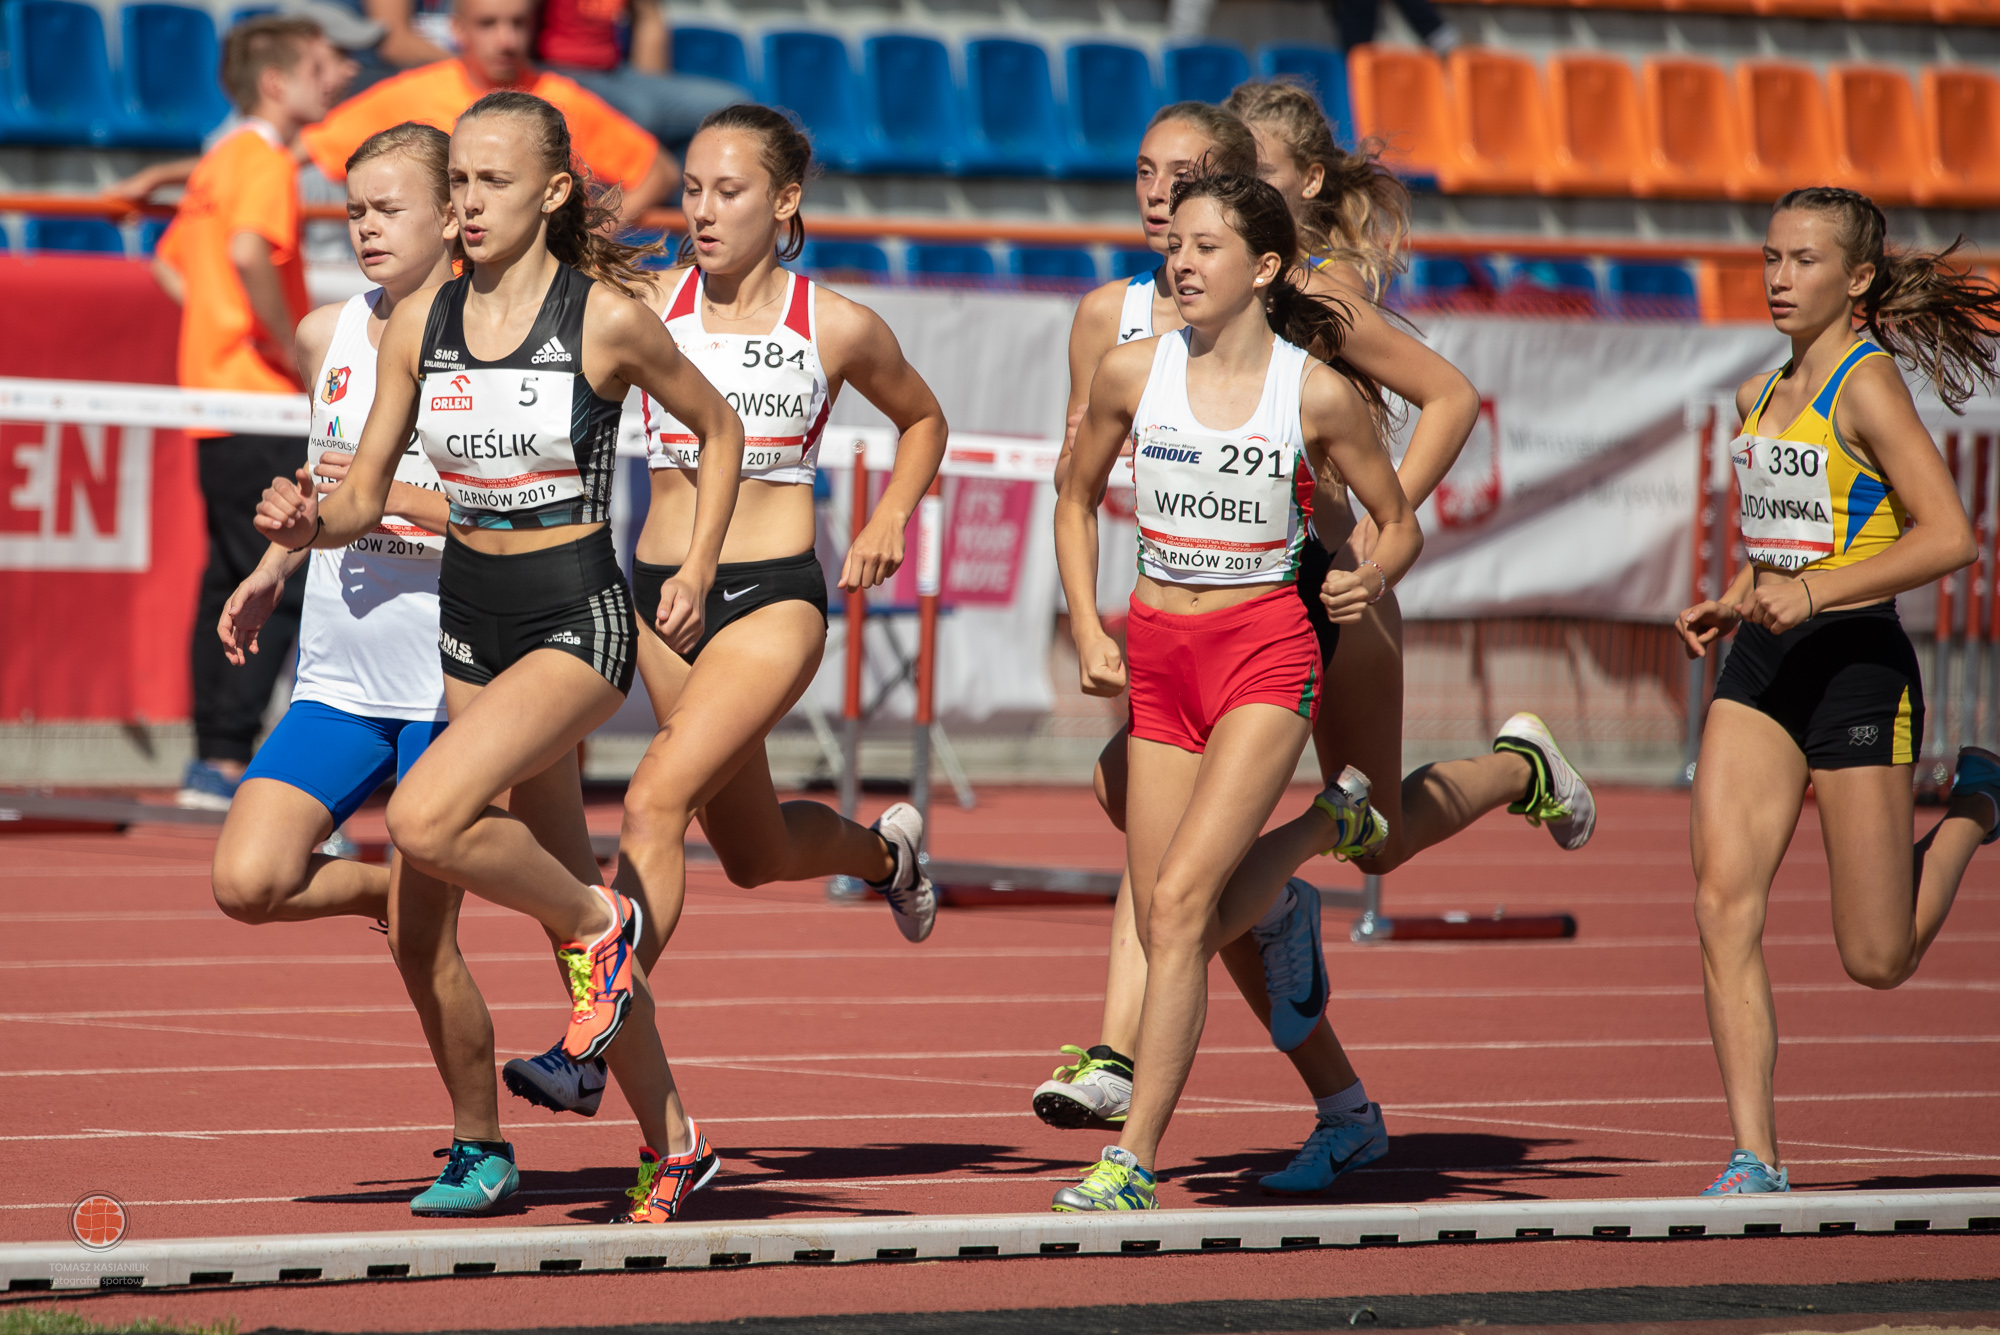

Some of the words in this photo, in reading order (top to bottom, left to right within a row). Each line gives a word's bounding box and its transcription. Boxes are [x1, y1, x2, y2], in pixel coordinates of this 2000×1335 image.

[424, 360, 448, 369] SZKLARSKA
[434, 349, 459, 361] SMS
[531, 351, 572, 364] adidas
[742, 341, 805, 370] 584
[518, 377, 539, 407] 5
[432, 397, 471, 410] ORLEN
[310, 437, 358, 452] MAŁOPOLSK
[446, 429, 541, 459] CIEŚLIK
[678, 449, 699, 463] TAR
[747, 452, 781, 466] 2019
[1141, 445, 1203, 465] 4MOVE
[1218, 444, 1286, 478] 291
[1769, 445, 1819, 478] 330
[458, 489, 513, 507] TARNÓW
[518, 484, 556, 506] 2019
[1154, 490, 1268, 524] WRÓBEL
[387, 540, 425, 556] 2019
[1157, 548, 1220, 569] TARNÓW
[1225, 556, 1262, 570] 2019
[1779, 554, 1809, 569] 2019
